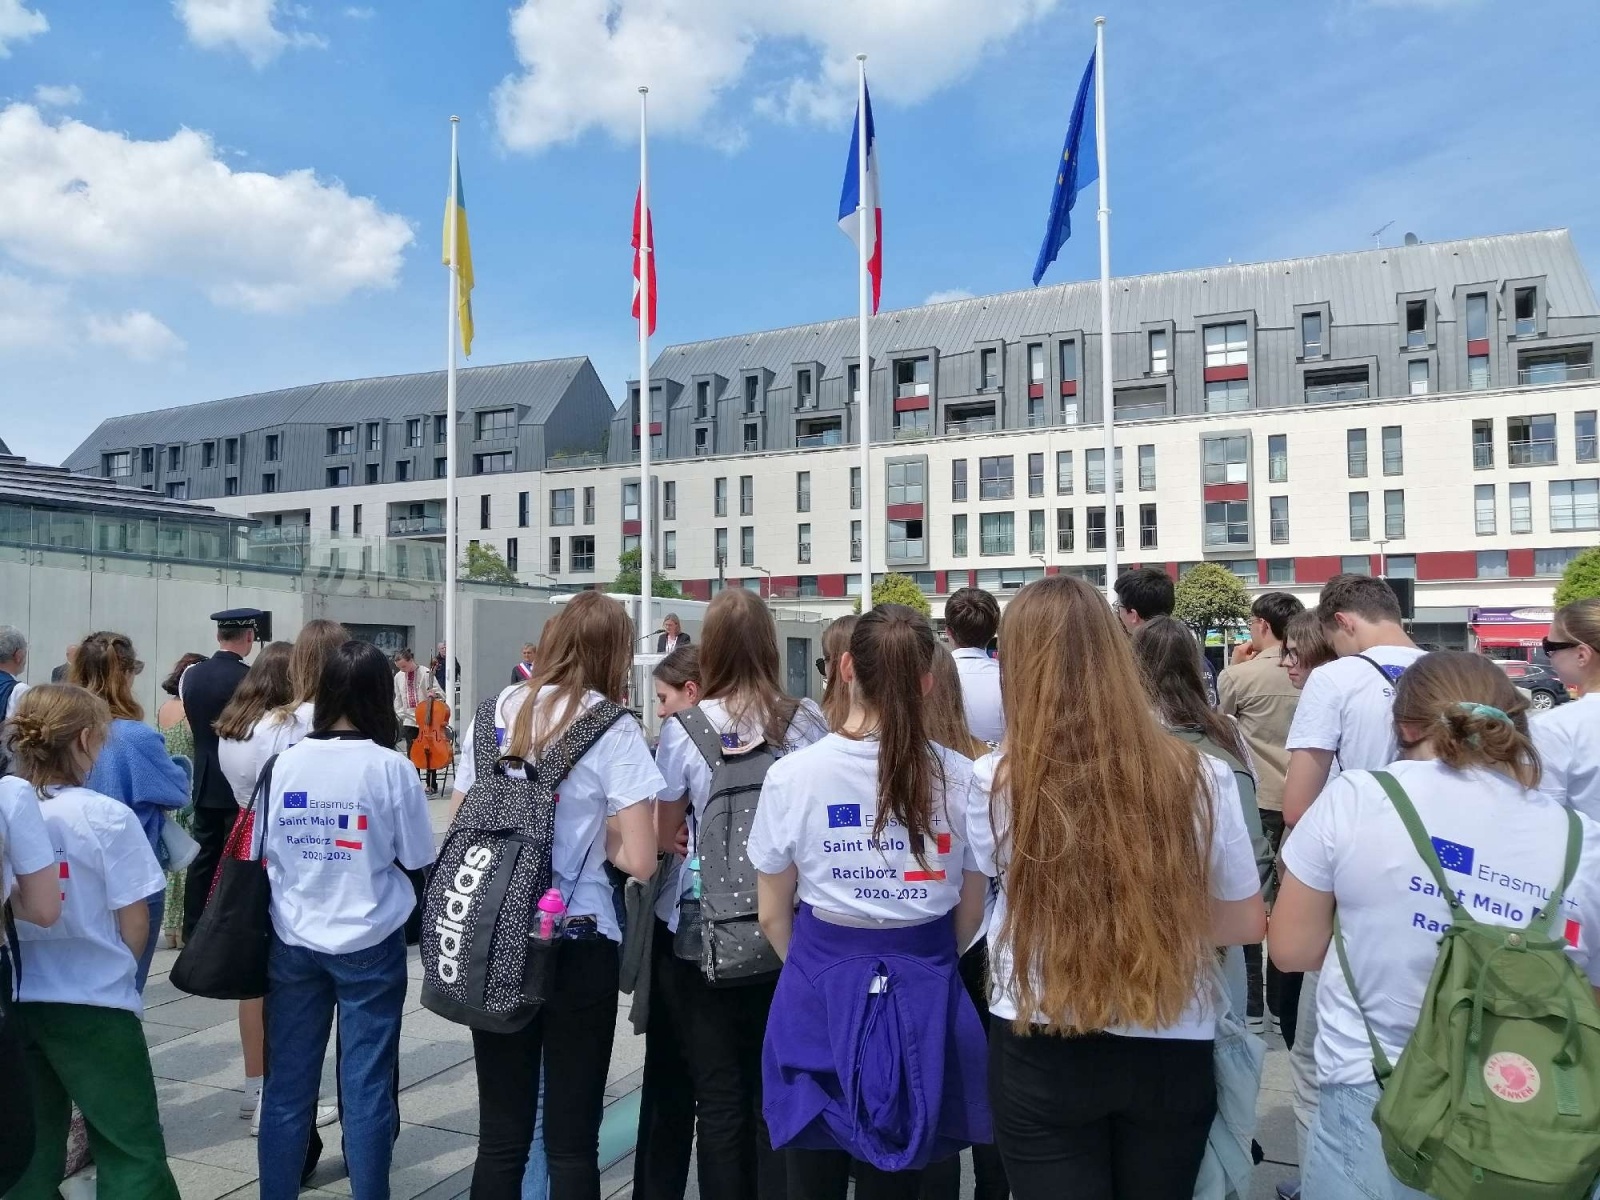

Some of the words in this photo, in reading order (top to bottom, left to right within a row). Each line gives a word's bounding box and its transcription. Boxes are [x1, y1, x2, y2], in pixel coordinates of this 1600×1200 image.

[309, 799, 363, 810] Erasmus+
[278, 816, 307, 827] Saint
[310, 816, 336, 826] Malo
[823, 839, 863, 853] Saint
[867, 838, 905, 851] Malo
[302, 850, 352, 861] 2020-2023
[854, 887, 928, 900] 2020-2023
[1409, 875, 1466, 905] Sait
[1473, 893, 1524, 922] Malo
[436, 845, 492, 984] adidas
